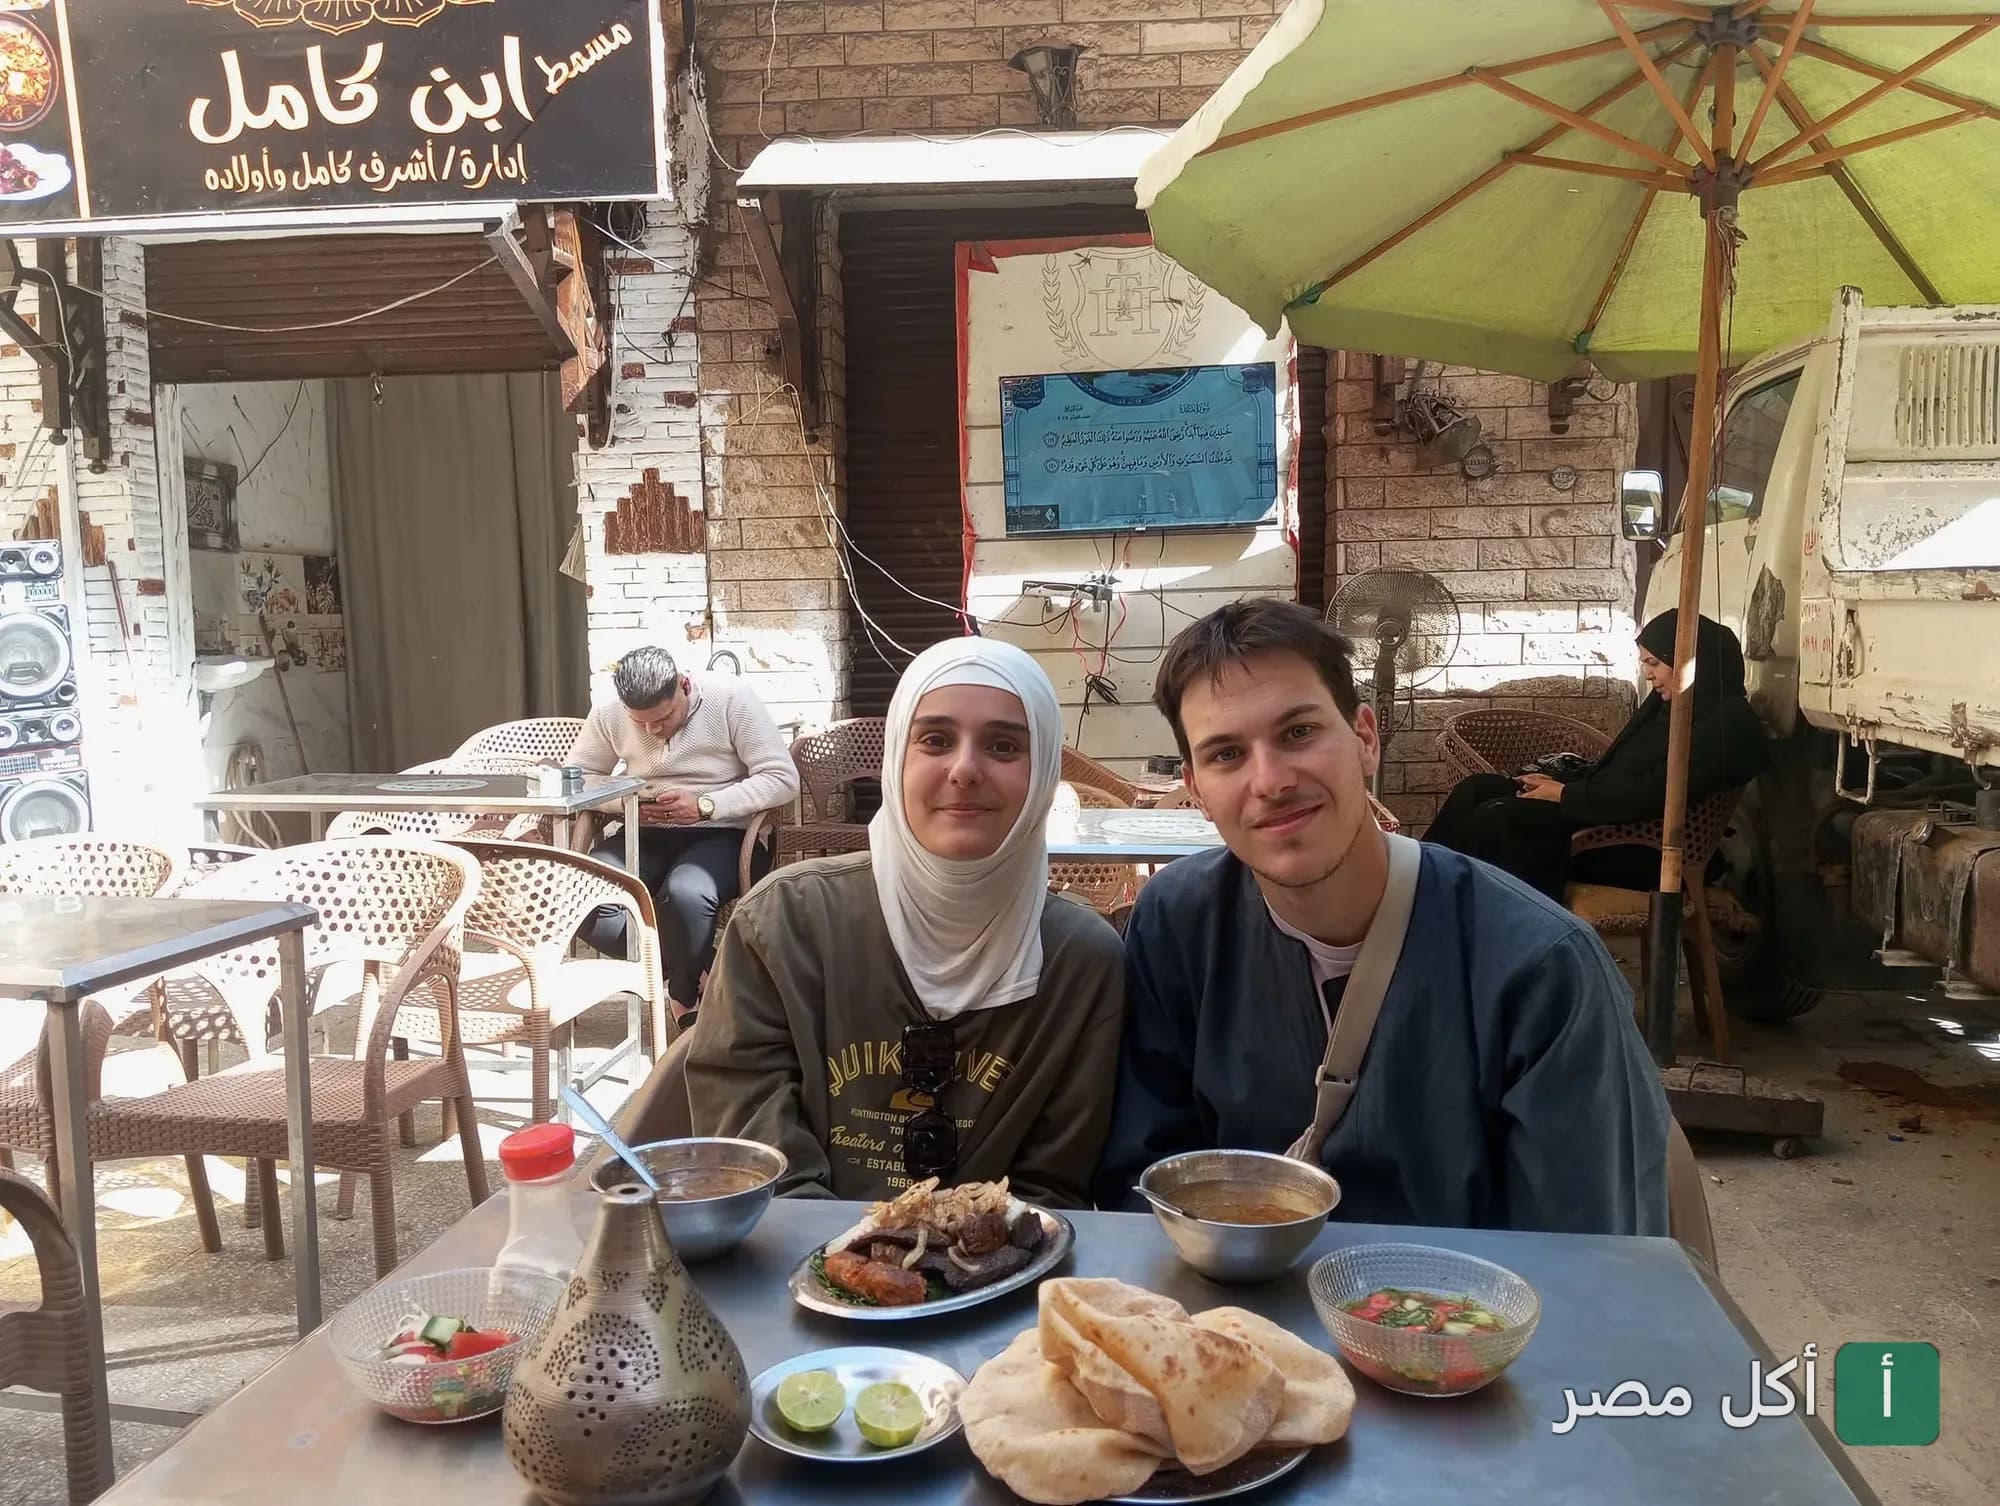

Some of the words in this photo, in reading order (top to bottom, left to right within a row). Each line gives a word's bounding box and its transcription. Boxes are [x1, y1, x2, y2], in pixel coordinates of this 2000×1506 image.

[410, 35, 535, 134] ابن
[534, 23, 632, 94] مسمط
[189, 42, 384, 144] كامل
[205, 147, 287, 192] وأولاده
[292, 150, 353, 191] كامل
[359, 139, 438, 192] أشرف
[866, 1158, 907, 1173] ESTABL
